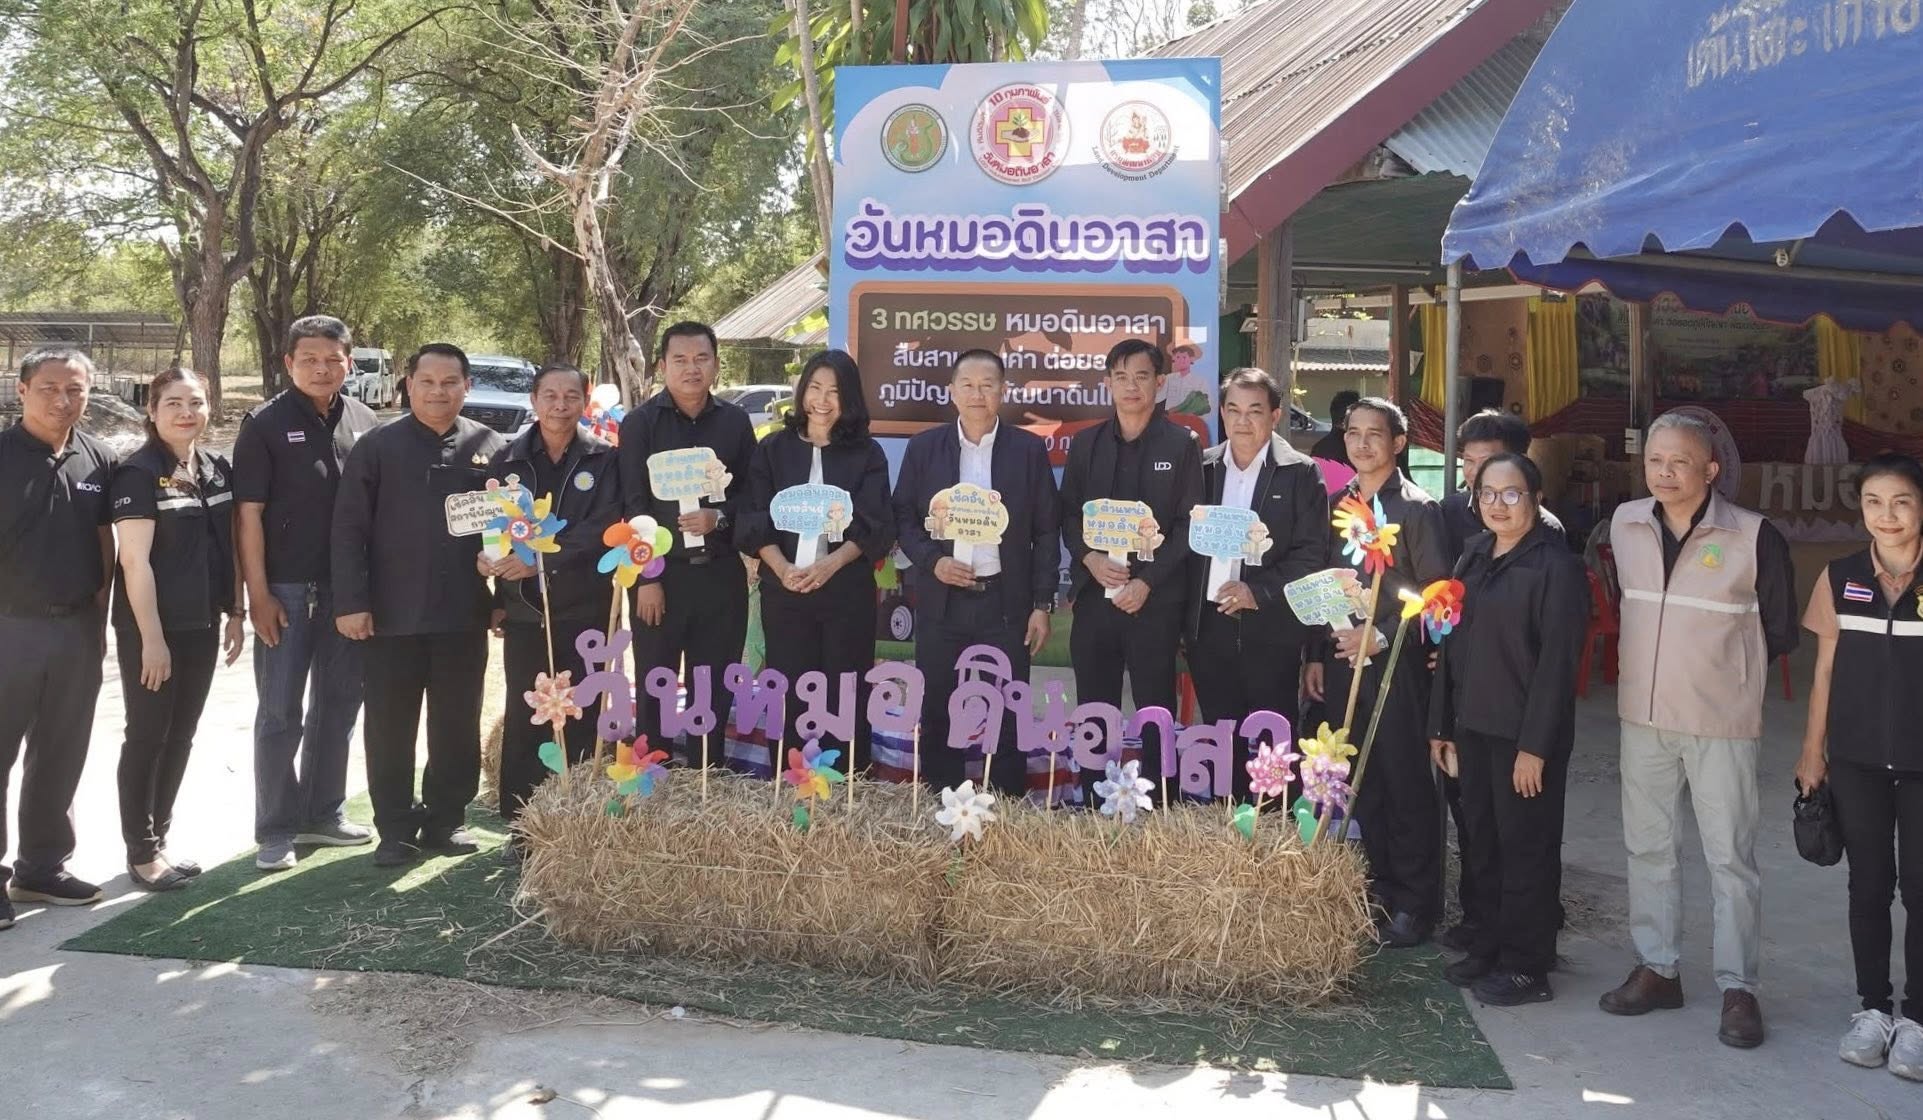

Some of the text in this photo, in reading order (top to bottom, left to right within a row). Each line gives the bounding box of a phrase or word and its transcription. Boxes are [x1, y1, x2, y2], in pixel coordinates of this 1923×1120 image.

[988, 92, 1004, 106] 10
[983, 152, 1056, 177] วันหมอดินอาสา
[1102, 162, 1147, 181] Development
[1148, 145, 1181, 179] Department
[847, 200, 1209, 259] วันหมอดินอาสา
[871, 308, 1166, 335] 3 ทศวรรษ หมอดินอาสา
[1044, 346, 1108, 371] ต่อยอ
[879, 380, 952, 407] ภูมิปัญ
[1154, 461, 1172, 471] LDD
[1760, 464, 1862, 511] หมอ
[950, 489, 985, 506] เช็คอิน
[949, 513, 998, 527] วันหมอดิน
[1087, 517, 1137, 532] หมอดิน
[958, 528, 982, 537] อาสา
[1093, 531, 1128, 546] ตำบล
[1194, 523, 1245, 537] หมอดิน
